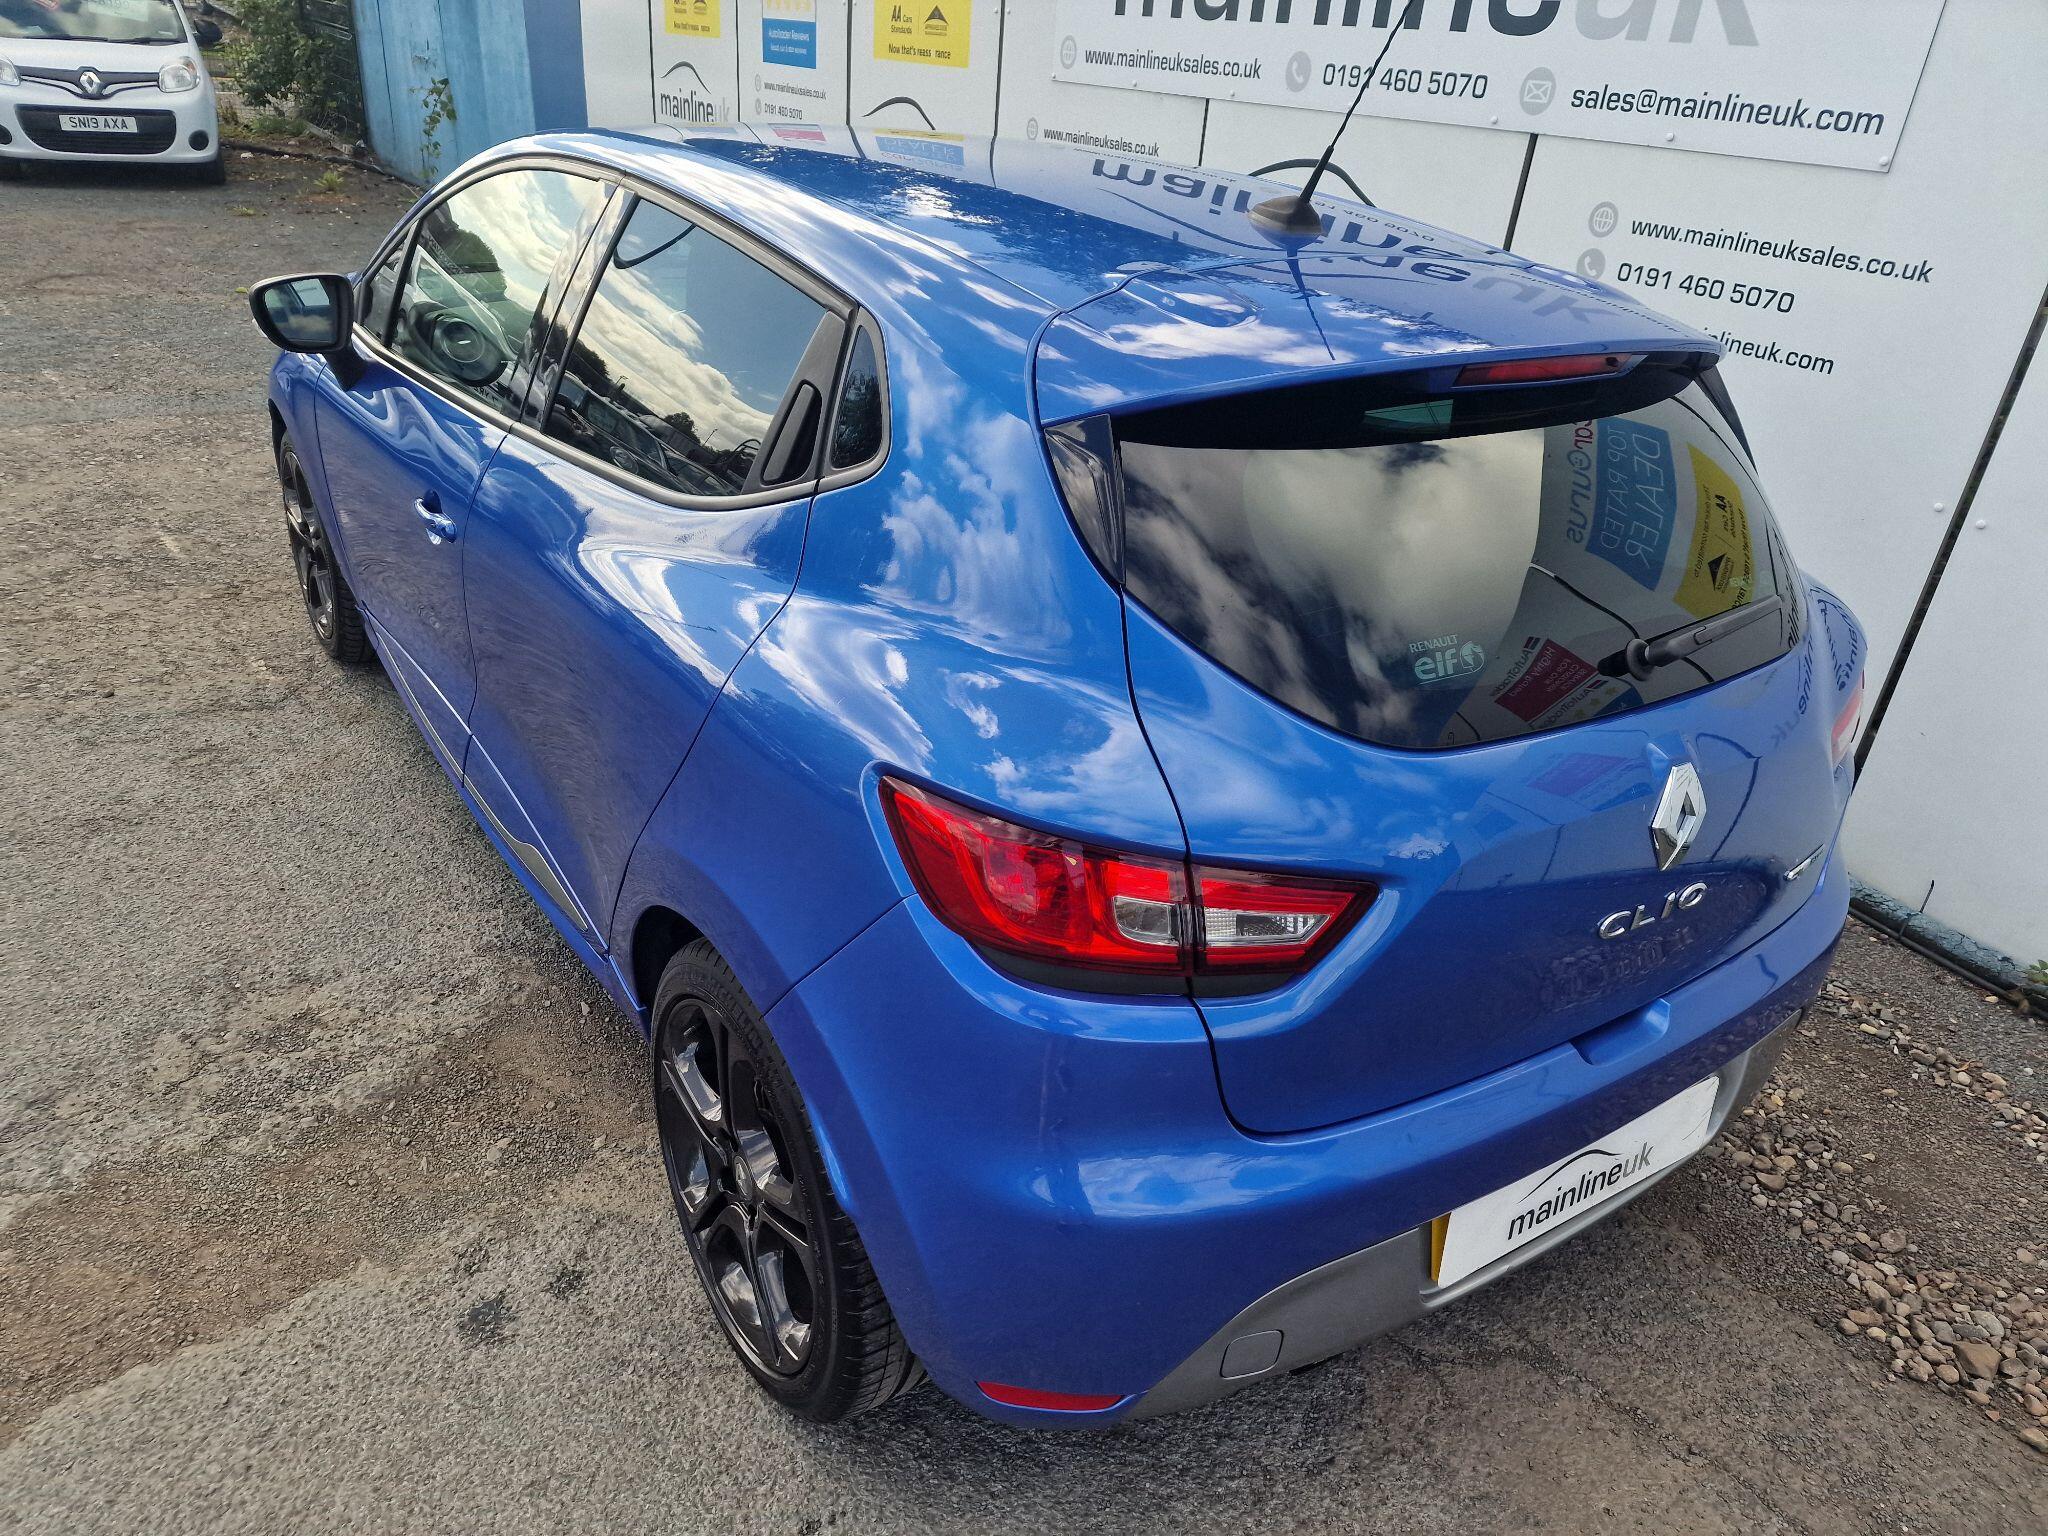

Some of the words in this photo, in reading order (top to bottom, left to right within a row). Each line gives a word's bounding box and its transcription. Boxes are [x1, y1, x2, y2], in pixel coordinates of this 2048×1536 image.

[890, 5, 902, 22] AA
[1085, 49, 1262, 79] www.mainlineuksales.co.uk
[1323, 63, 1374, 89] 0191
[1380, 67, 1422, 93] 460
[1427, 70, 1489, 99] 5070
[1571, 84, 1885, 136] sales@mainlineuk.com
[69, 116, 99, 129] SN19
[103, 117, 129, 130] AXA
[1043, 128, 1160, 158] www.mainlineuksales.co.uk
[1631, 219, 1934, 284] www.mainlineuksales.co.uk
[1617, 262, 1672, 290] 0191
[1679, 274, 1725, 300] 460
[1730, 282, 1796, 314] 5070
[1704, 326, 1834, 376] lineuk.com
[1409, 634, 1458, 653] RENAULT
[1414, 648, 1458, 680] elf
[1598, 882, 1709, 940] CLIO
[1507, 1141, 1654, 1241] mainlineuk
